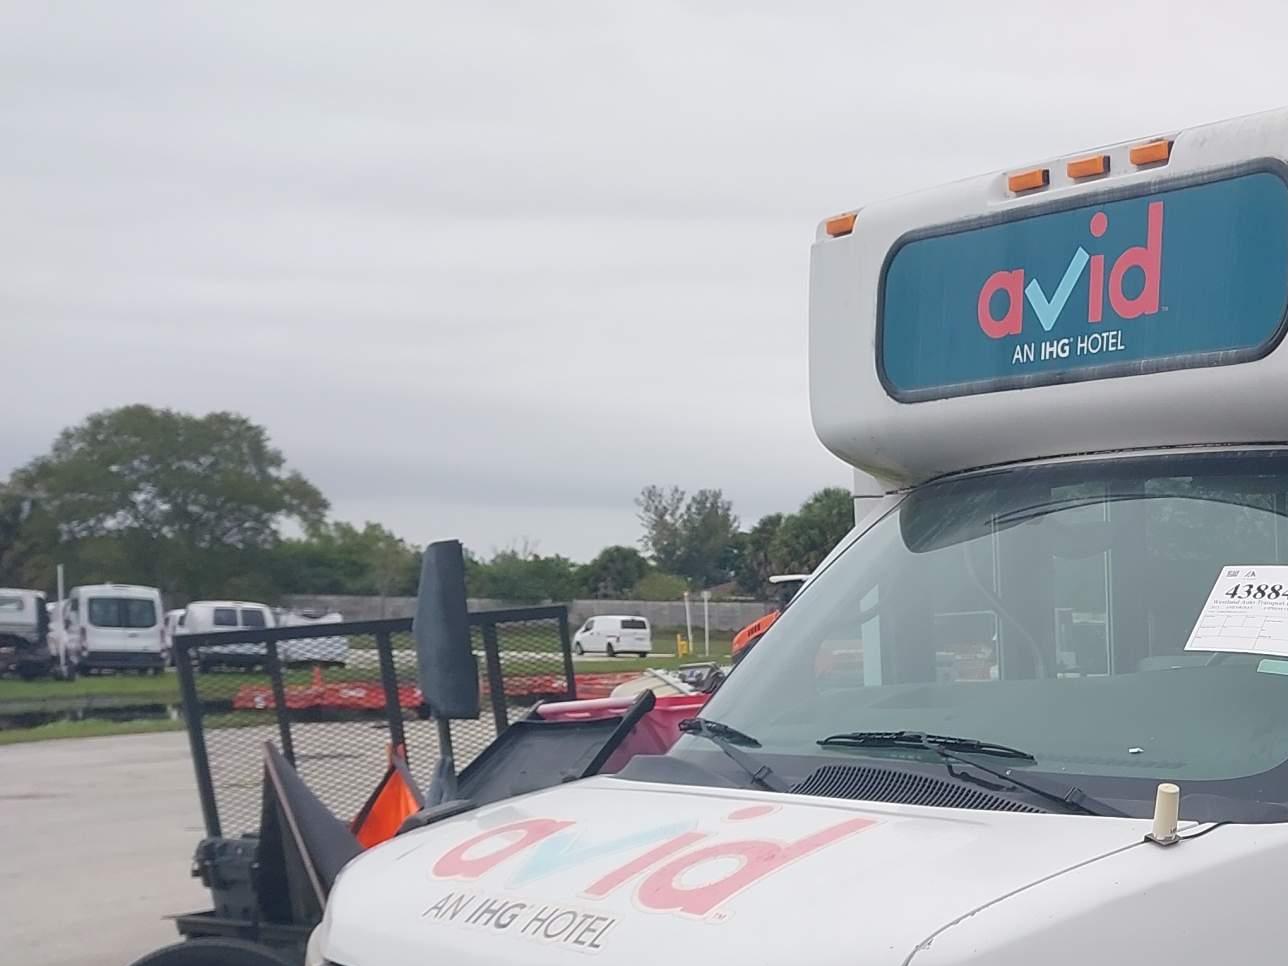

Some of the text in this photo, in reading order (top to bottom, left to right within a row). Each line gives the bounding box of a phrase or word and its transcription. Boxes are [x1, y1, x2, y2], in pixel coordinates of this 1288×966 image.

[977, 200, 1165, 340] avid
[1012, 330, 1126, 364] AN IHG HOTEL
[432, 803, 879, 916] avid
[422, 892, 617, 950] AN IHG HOTEL
